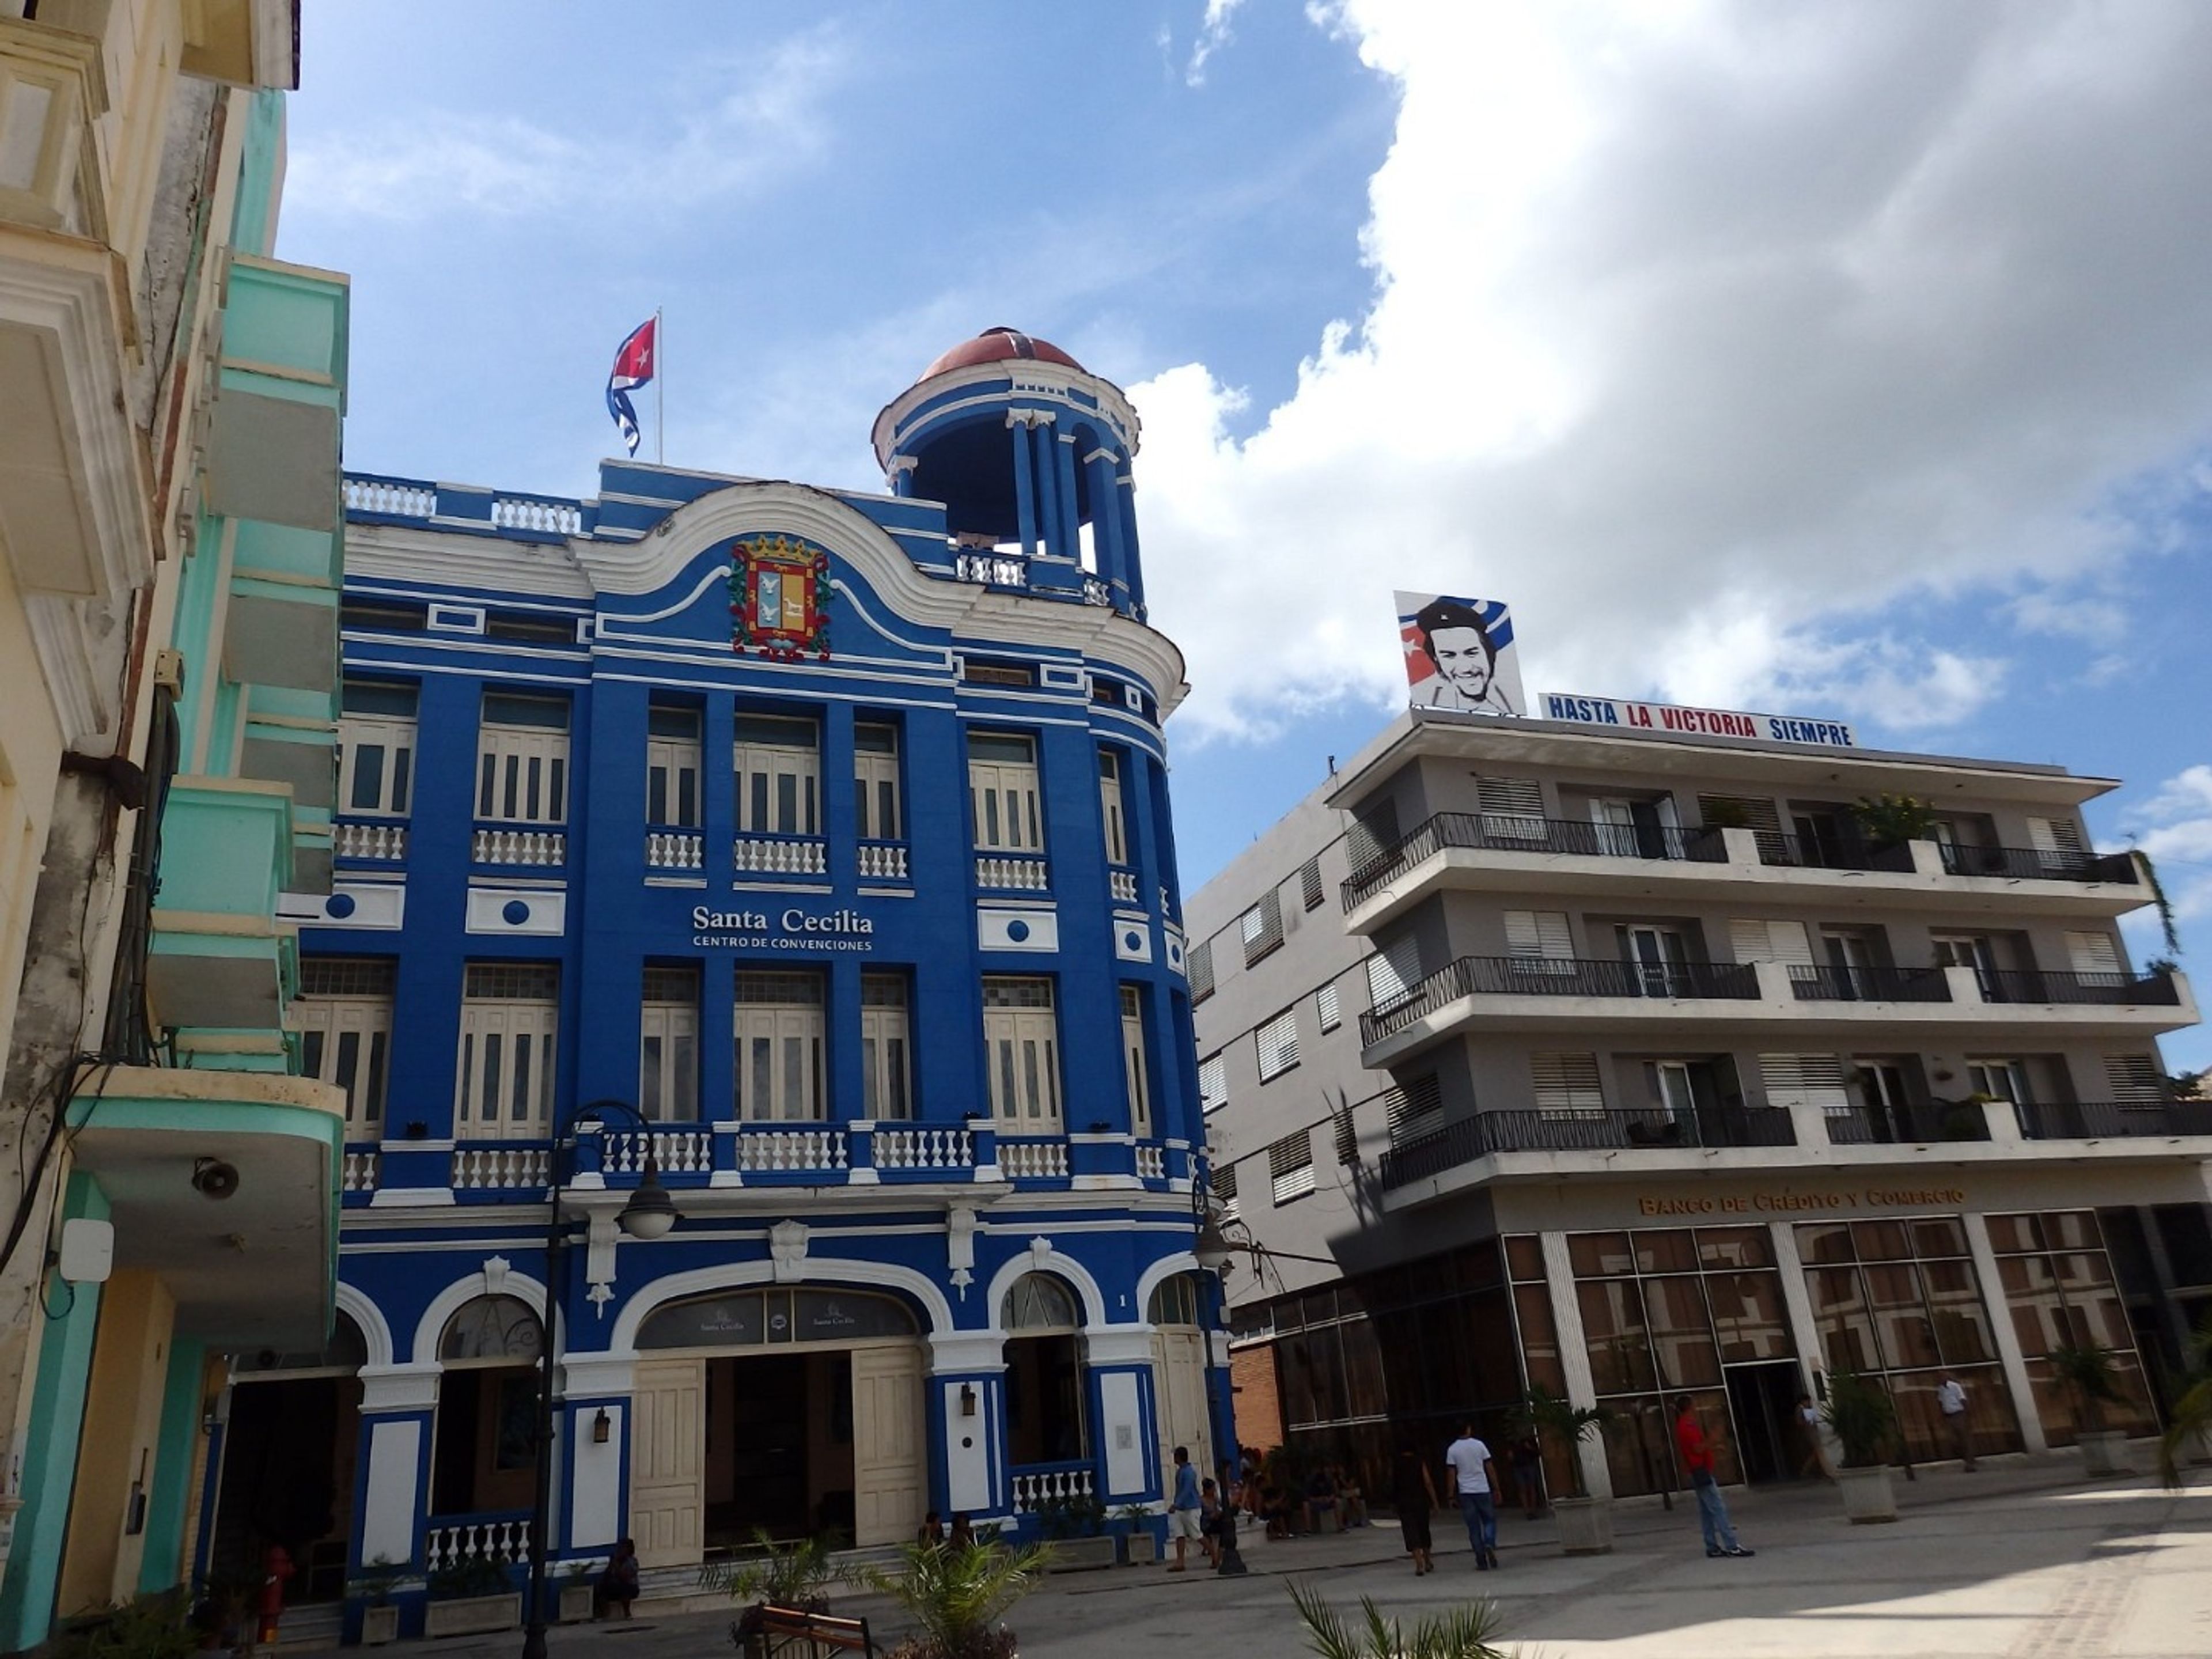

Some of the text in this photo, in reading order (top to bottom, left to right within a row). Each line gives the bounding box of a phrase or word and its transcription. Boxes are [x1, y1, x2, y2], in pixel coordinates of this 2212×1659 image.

[1548, 696, 1853, 746] HASTA LA VICTORIA SIEMPRE
[693, 906, 873, 933] Santa Cecilia
[693, 935, 872, 951] CENTRO DE CONVENCIONES
[1638, 1197, 1713, 1215] BANCO
[1721, 1197, 1748, 1212] DE
[1844, 1192, 1858, 1207] Y
[1866, 1188, 1964, 1206] COMERCIO
